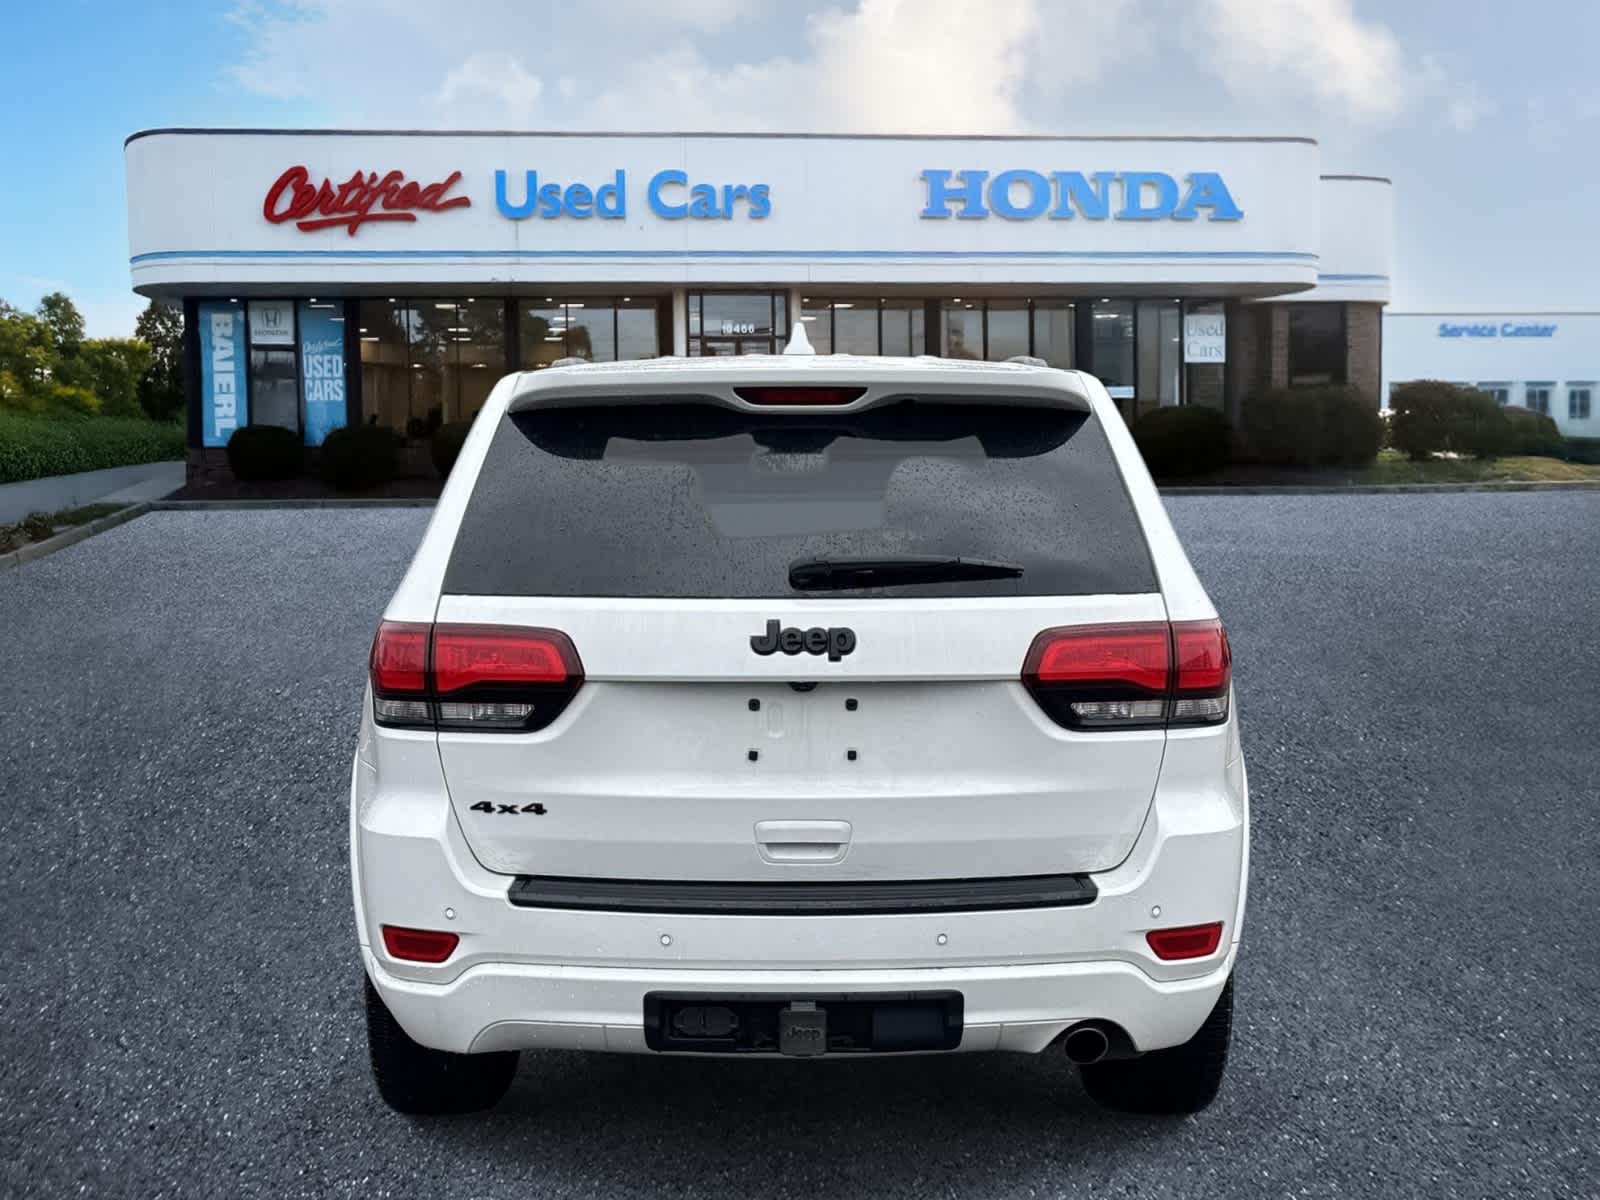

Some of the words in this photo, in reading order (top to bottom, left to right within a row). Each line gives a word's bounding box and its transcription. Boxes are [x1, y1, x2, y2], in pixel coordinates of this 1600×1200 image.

[264, 165, 471, 236] Certified
[495, 169, 626, 219] Used
[648, 169, 771, 219] Cars
[920, 169, 1244, 221] HONDA
[1187, 319, 1224, 336] Used
[1439, 323, 1496, 337] Service
[1501, 323, 1557, 337] Center
[1187, 341, 1223, 358] Cars
[211, 312, 237, 437] BAIERL
[303, 354, 343, 378] USED
[304, 379, 344, 401] CARS
[750, 619, 856, 662] Jeep
[470, 801, 547, 815] 4x4
